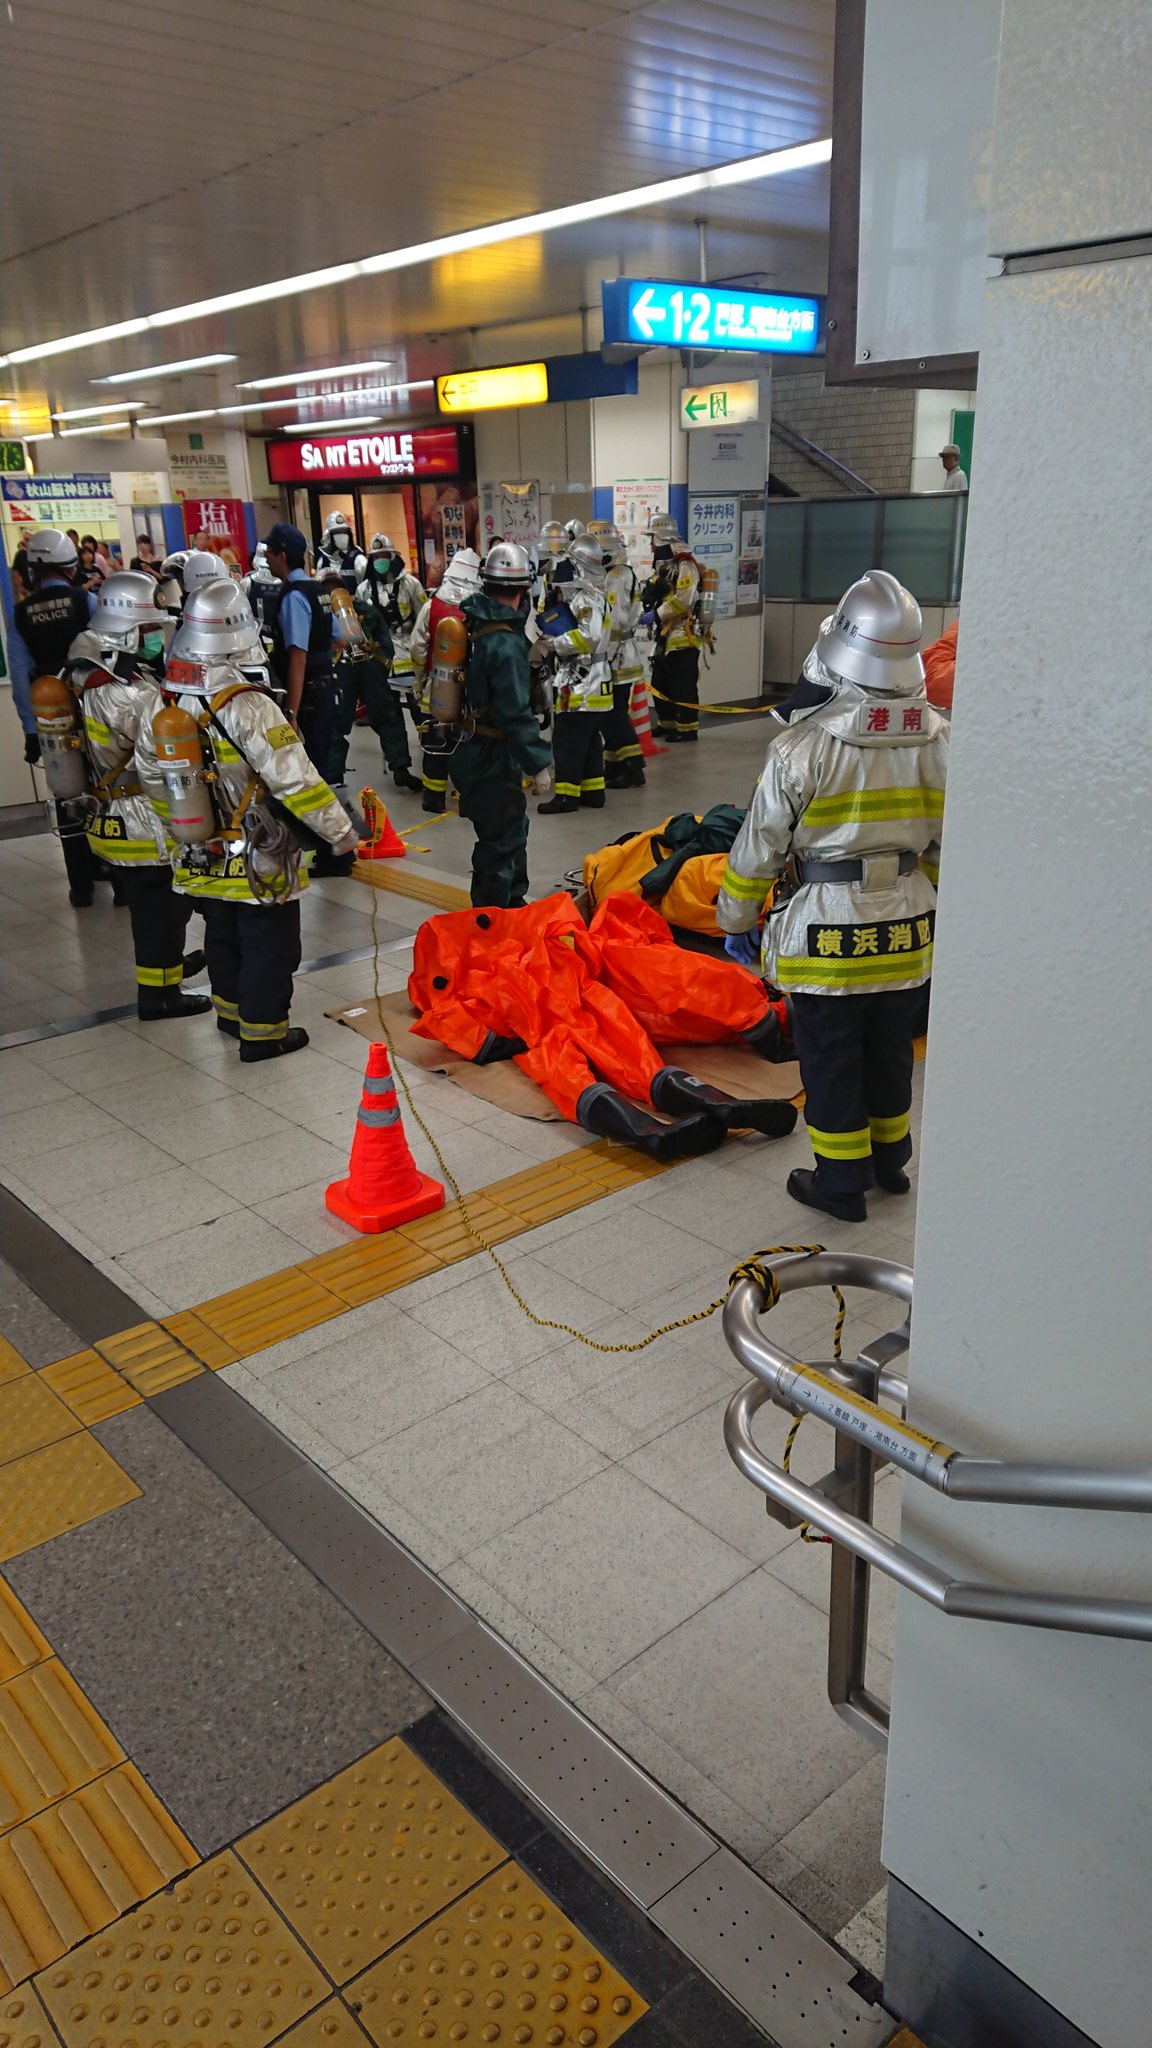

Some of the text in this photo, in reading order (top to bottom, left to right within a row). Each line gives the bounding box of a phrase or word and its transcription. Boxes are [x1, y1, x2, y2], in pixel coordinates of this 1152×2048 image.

[347, 434, 414, 466] ETOILE
[198, 502, 231, 535] 塩
[693, 503, 735, 520] 今井内科
[694, 522, 734, 536] クリニック
[32, 607, 69, 624] POLICE
[866, 706, 923, 732] 港南
[815, 917, 932, 956] 横浜消防
[900, 1444, 918, 1463] 方面
